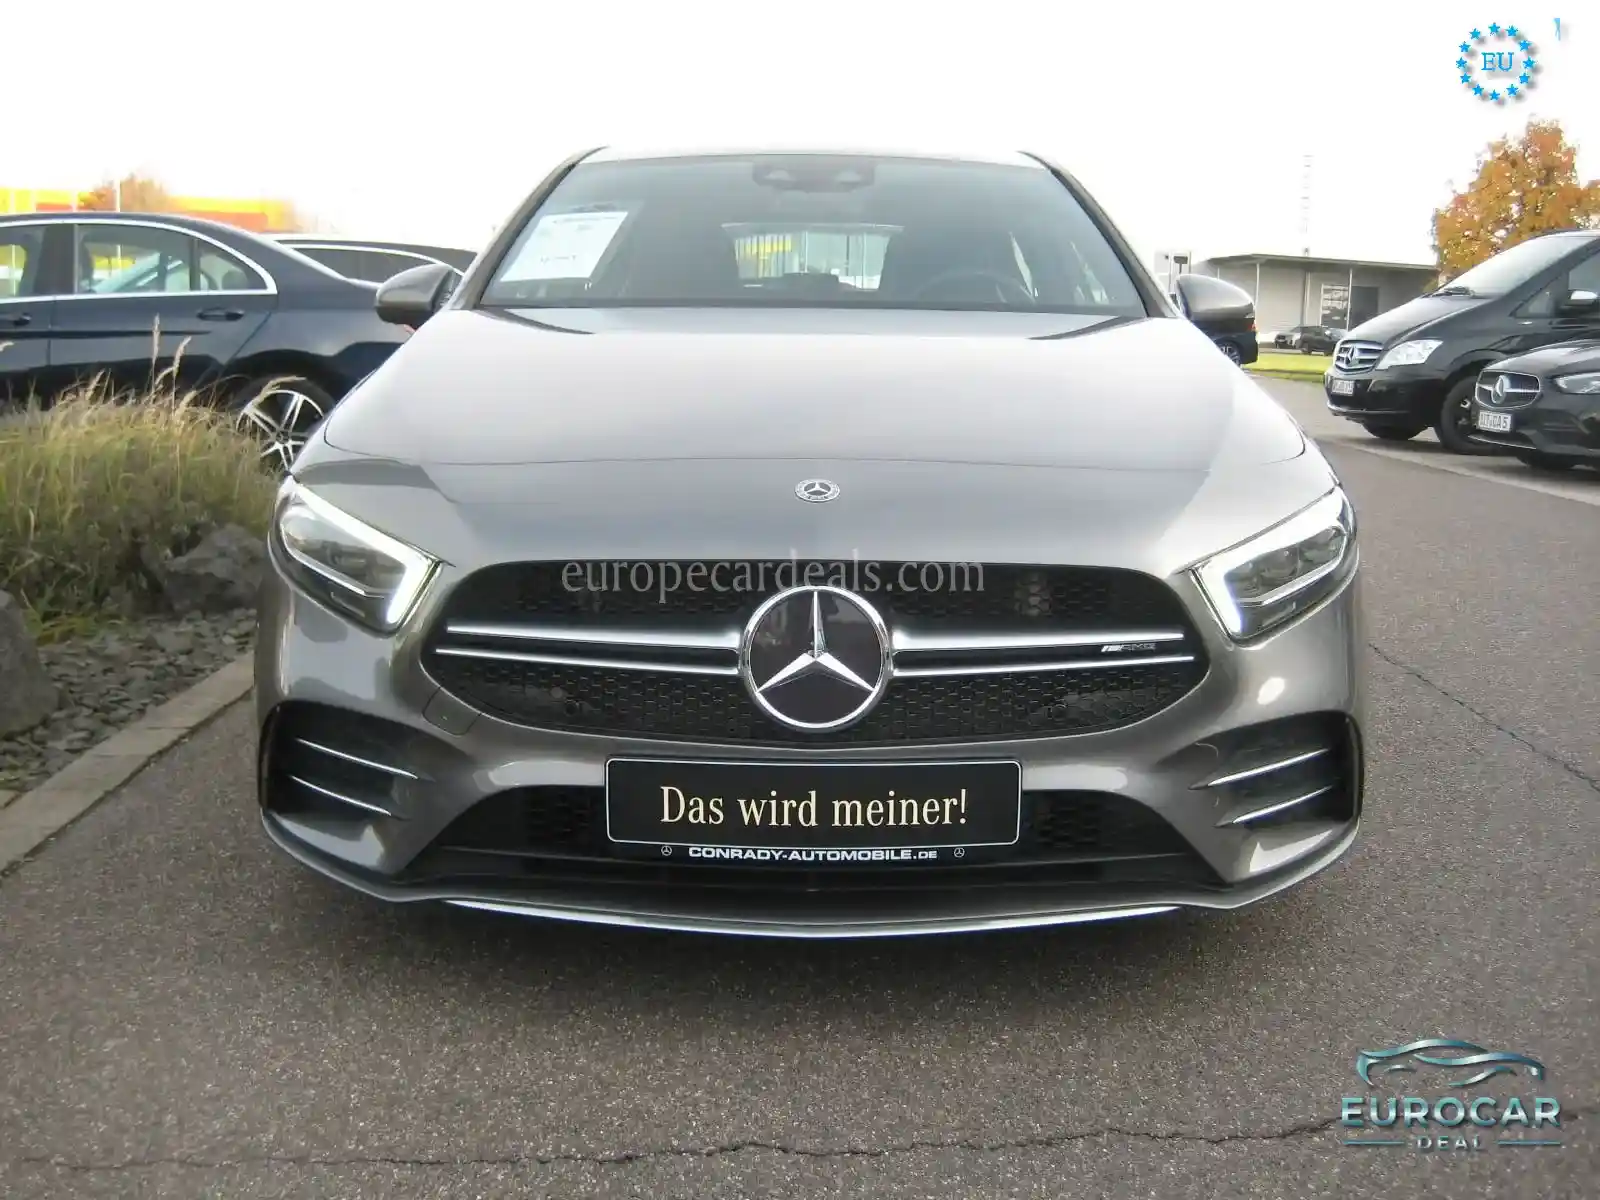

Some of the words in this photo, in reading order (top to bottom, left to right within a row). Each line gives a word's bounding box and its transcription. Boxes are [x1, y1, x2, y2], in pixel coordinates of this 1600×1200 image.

[660, 786, 724, 825] Das
[737, 790, 819, 827] wird
[832, 788, 967, 827] meiner!
[688, 846, 938, 862] CONRADY-AUTOMOBILE.DE
